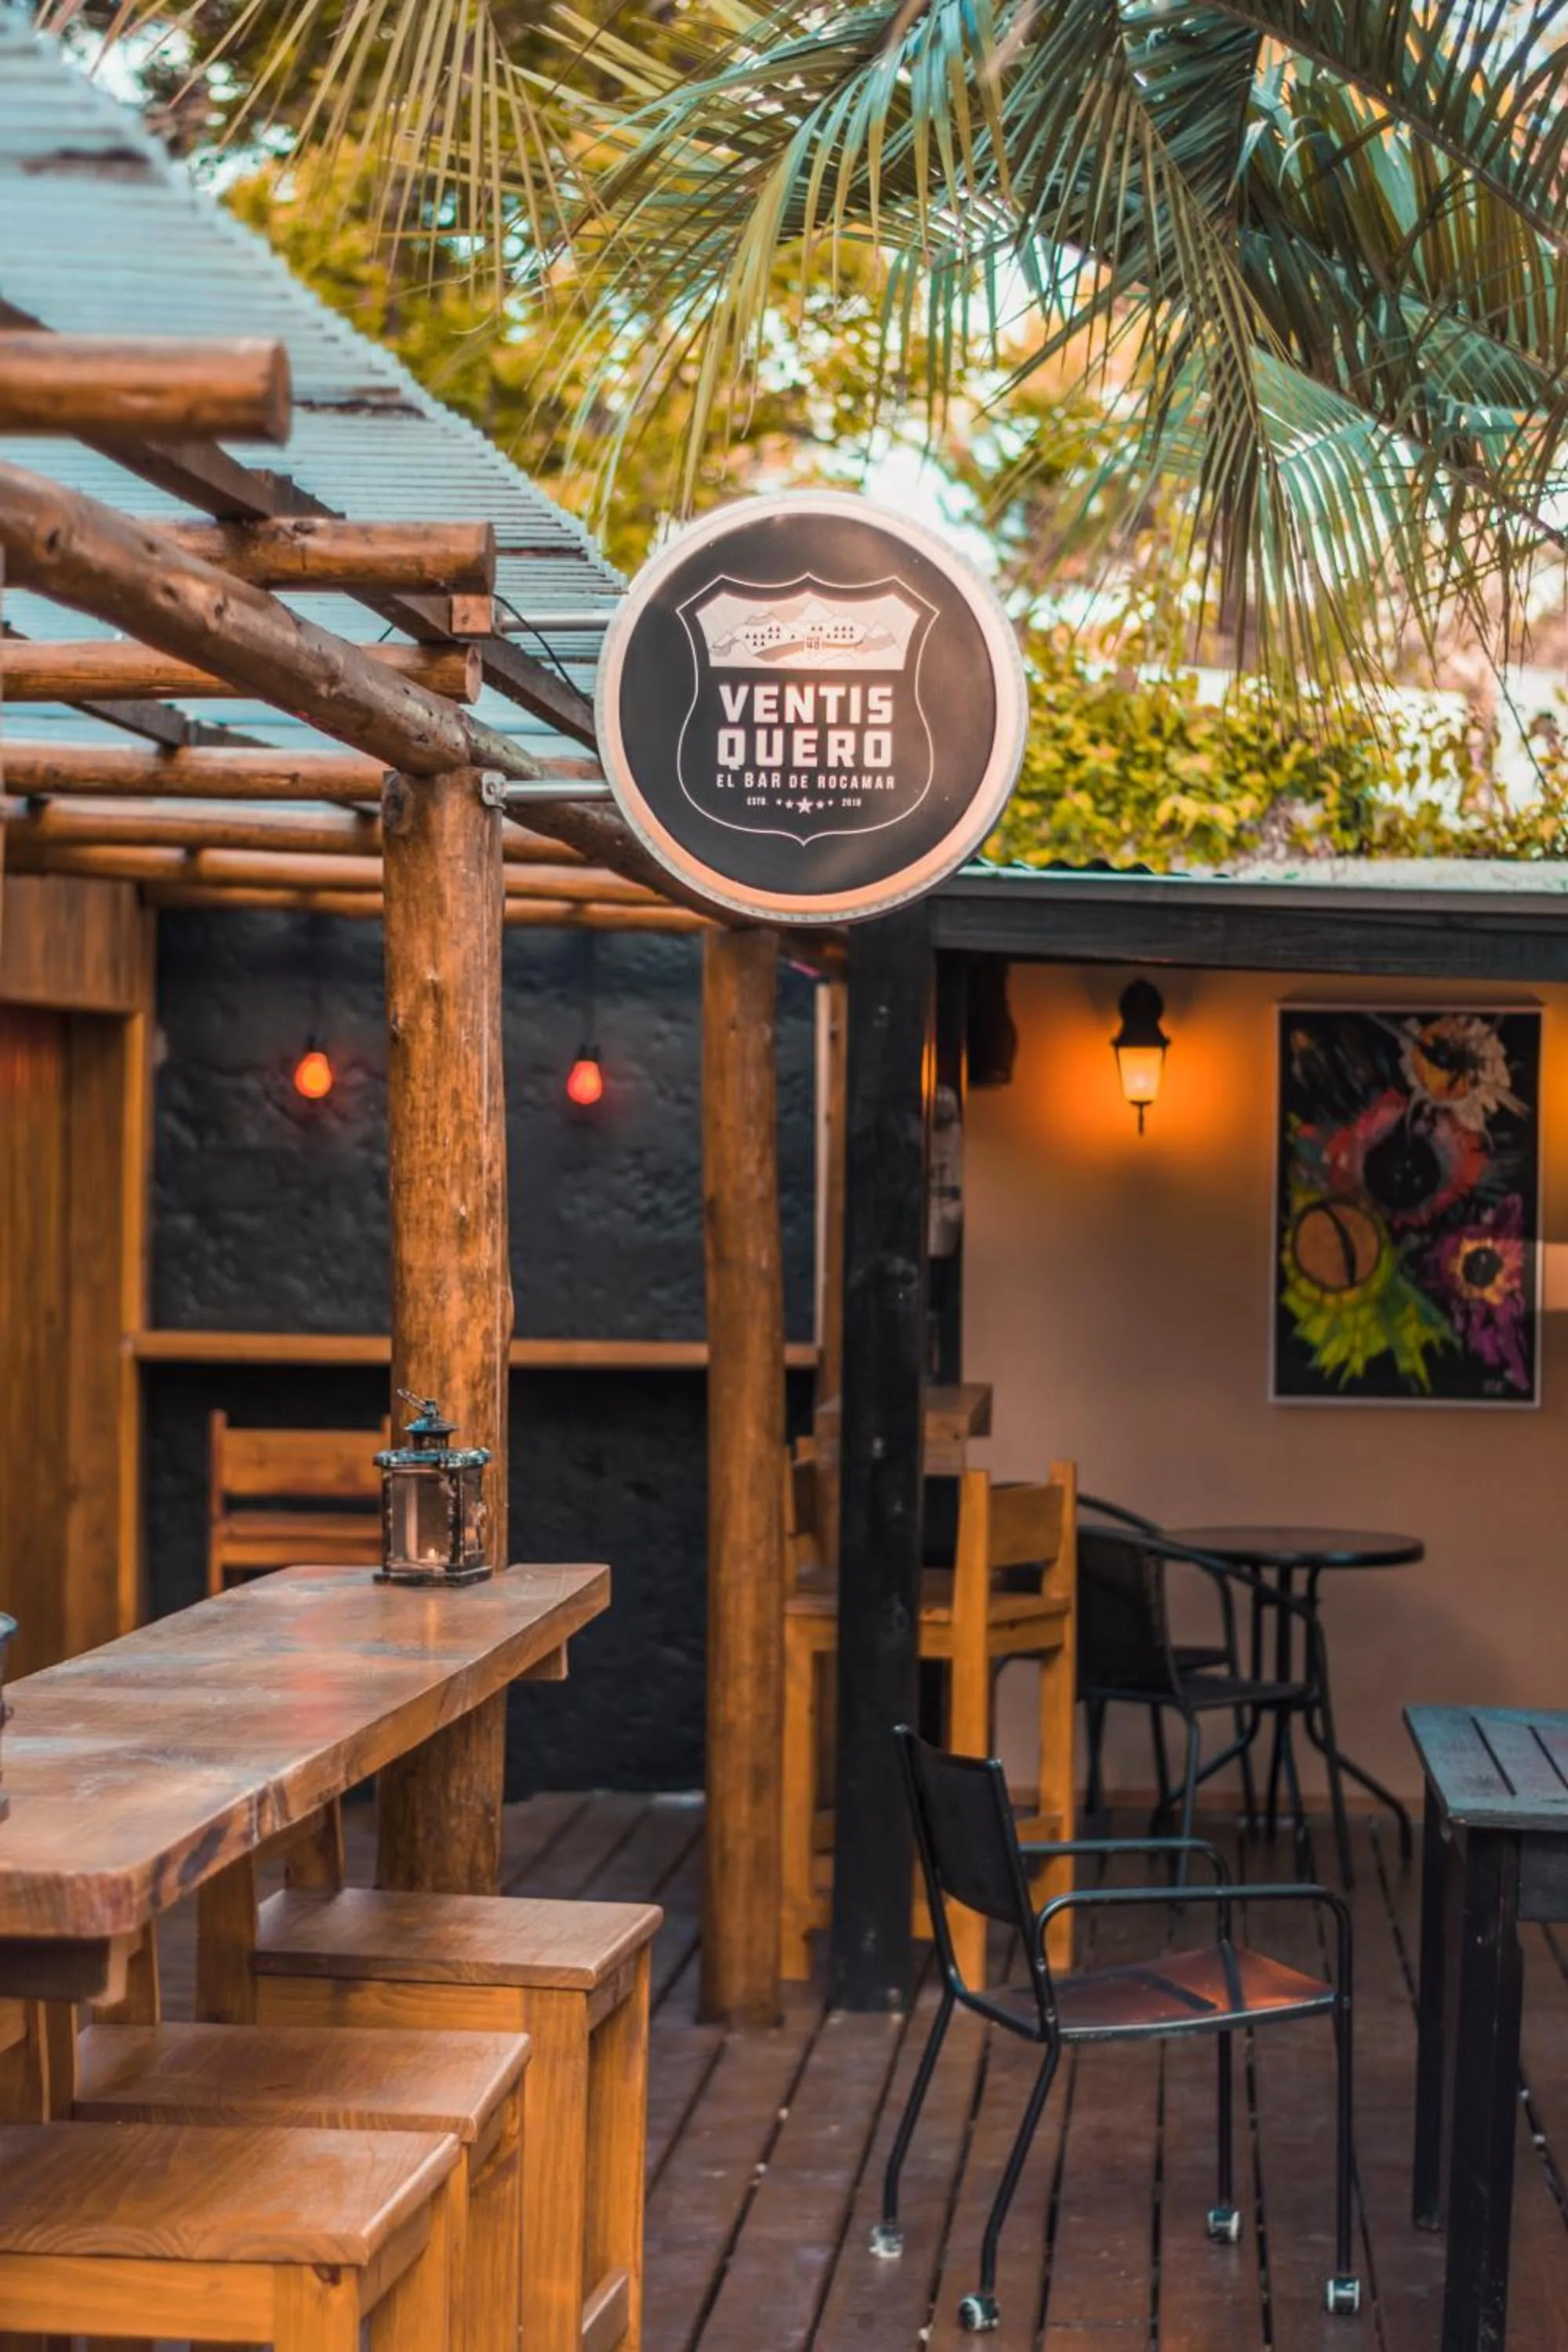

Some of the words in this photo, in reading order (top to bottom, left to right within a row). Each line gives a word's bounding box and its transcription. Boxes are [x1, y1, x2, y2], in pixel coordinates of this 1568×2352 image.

[718, 684, 893, 724] VENTIS
[717, 728, 892, 770] QUERO
[717, 774, 735, 788] EL
[745, 772, 781, 789] BAR
[789, 775, 808, 789] DE
[818, 775, 895, 789] ROCAMAR
